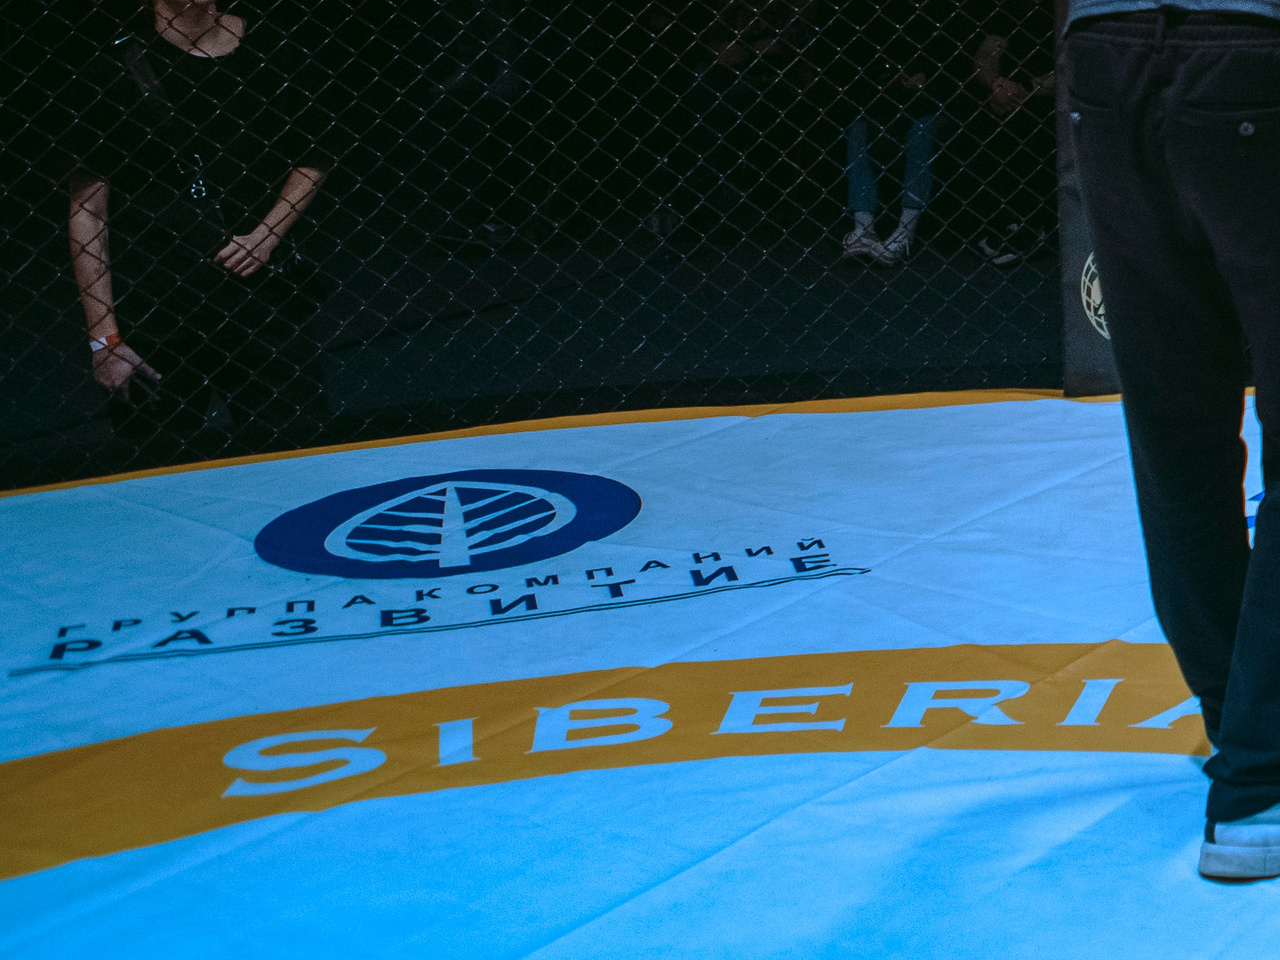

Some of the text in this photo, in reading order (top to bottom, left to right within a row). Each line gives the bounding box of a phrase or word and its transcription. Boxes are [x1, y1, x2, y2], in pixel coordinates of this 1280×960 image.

[49, 553, 838, 660] РАЗВИТИЕ
[57, 536, 826, 638] ГРУППА КОМПАНИЙ
